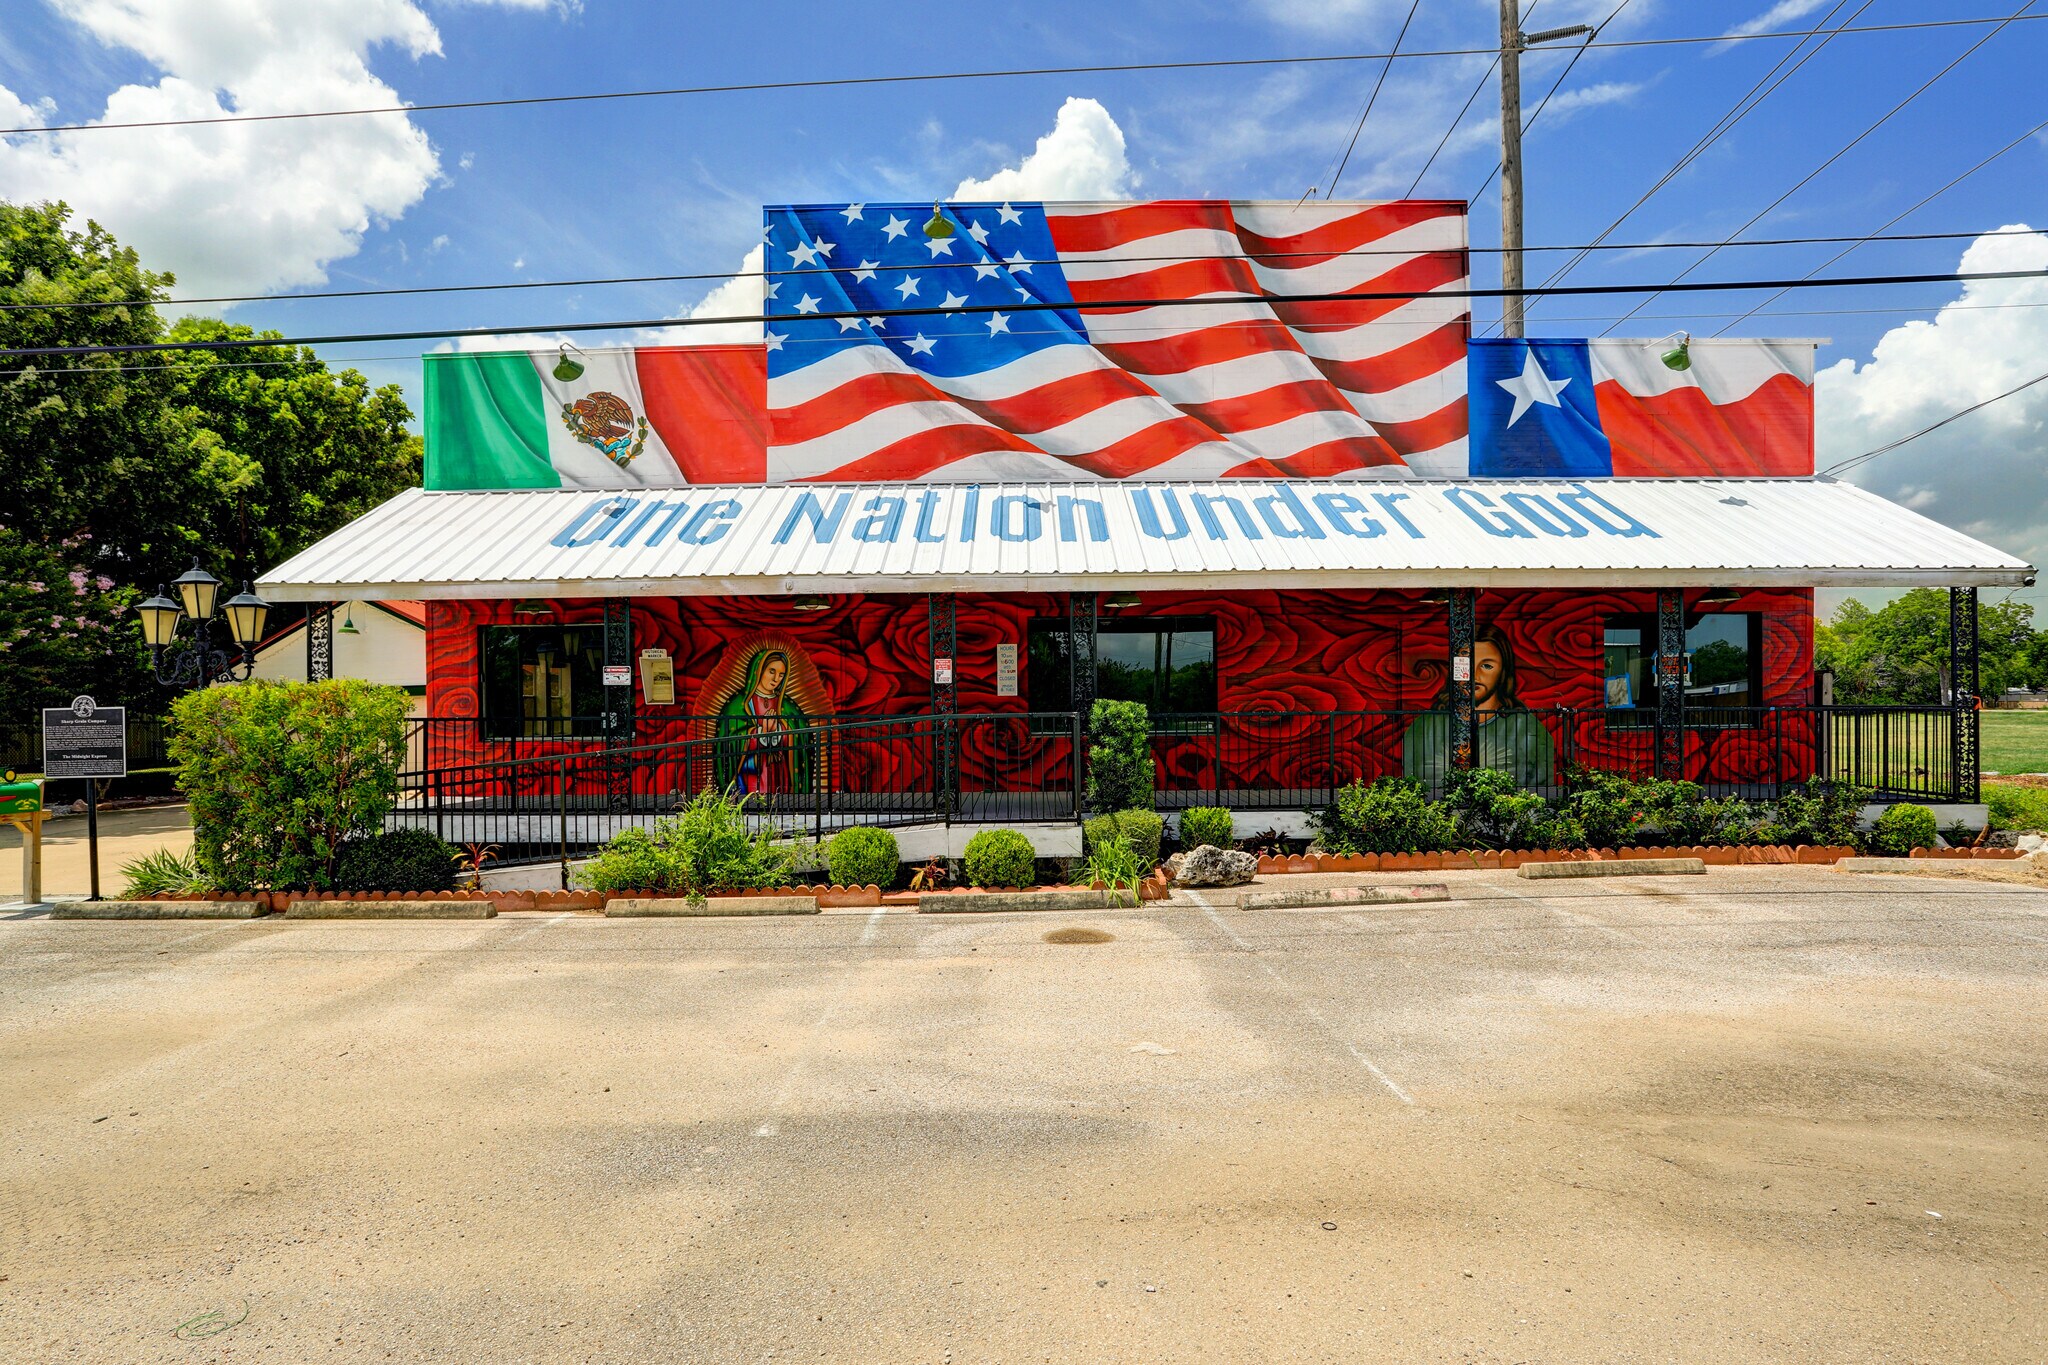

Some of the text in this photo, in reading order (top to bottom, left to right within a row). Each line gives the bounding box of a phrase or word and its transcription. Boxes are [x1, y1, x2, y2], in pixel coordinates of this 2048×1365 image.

[550, 483, 1664, 548] One Nation Under God
